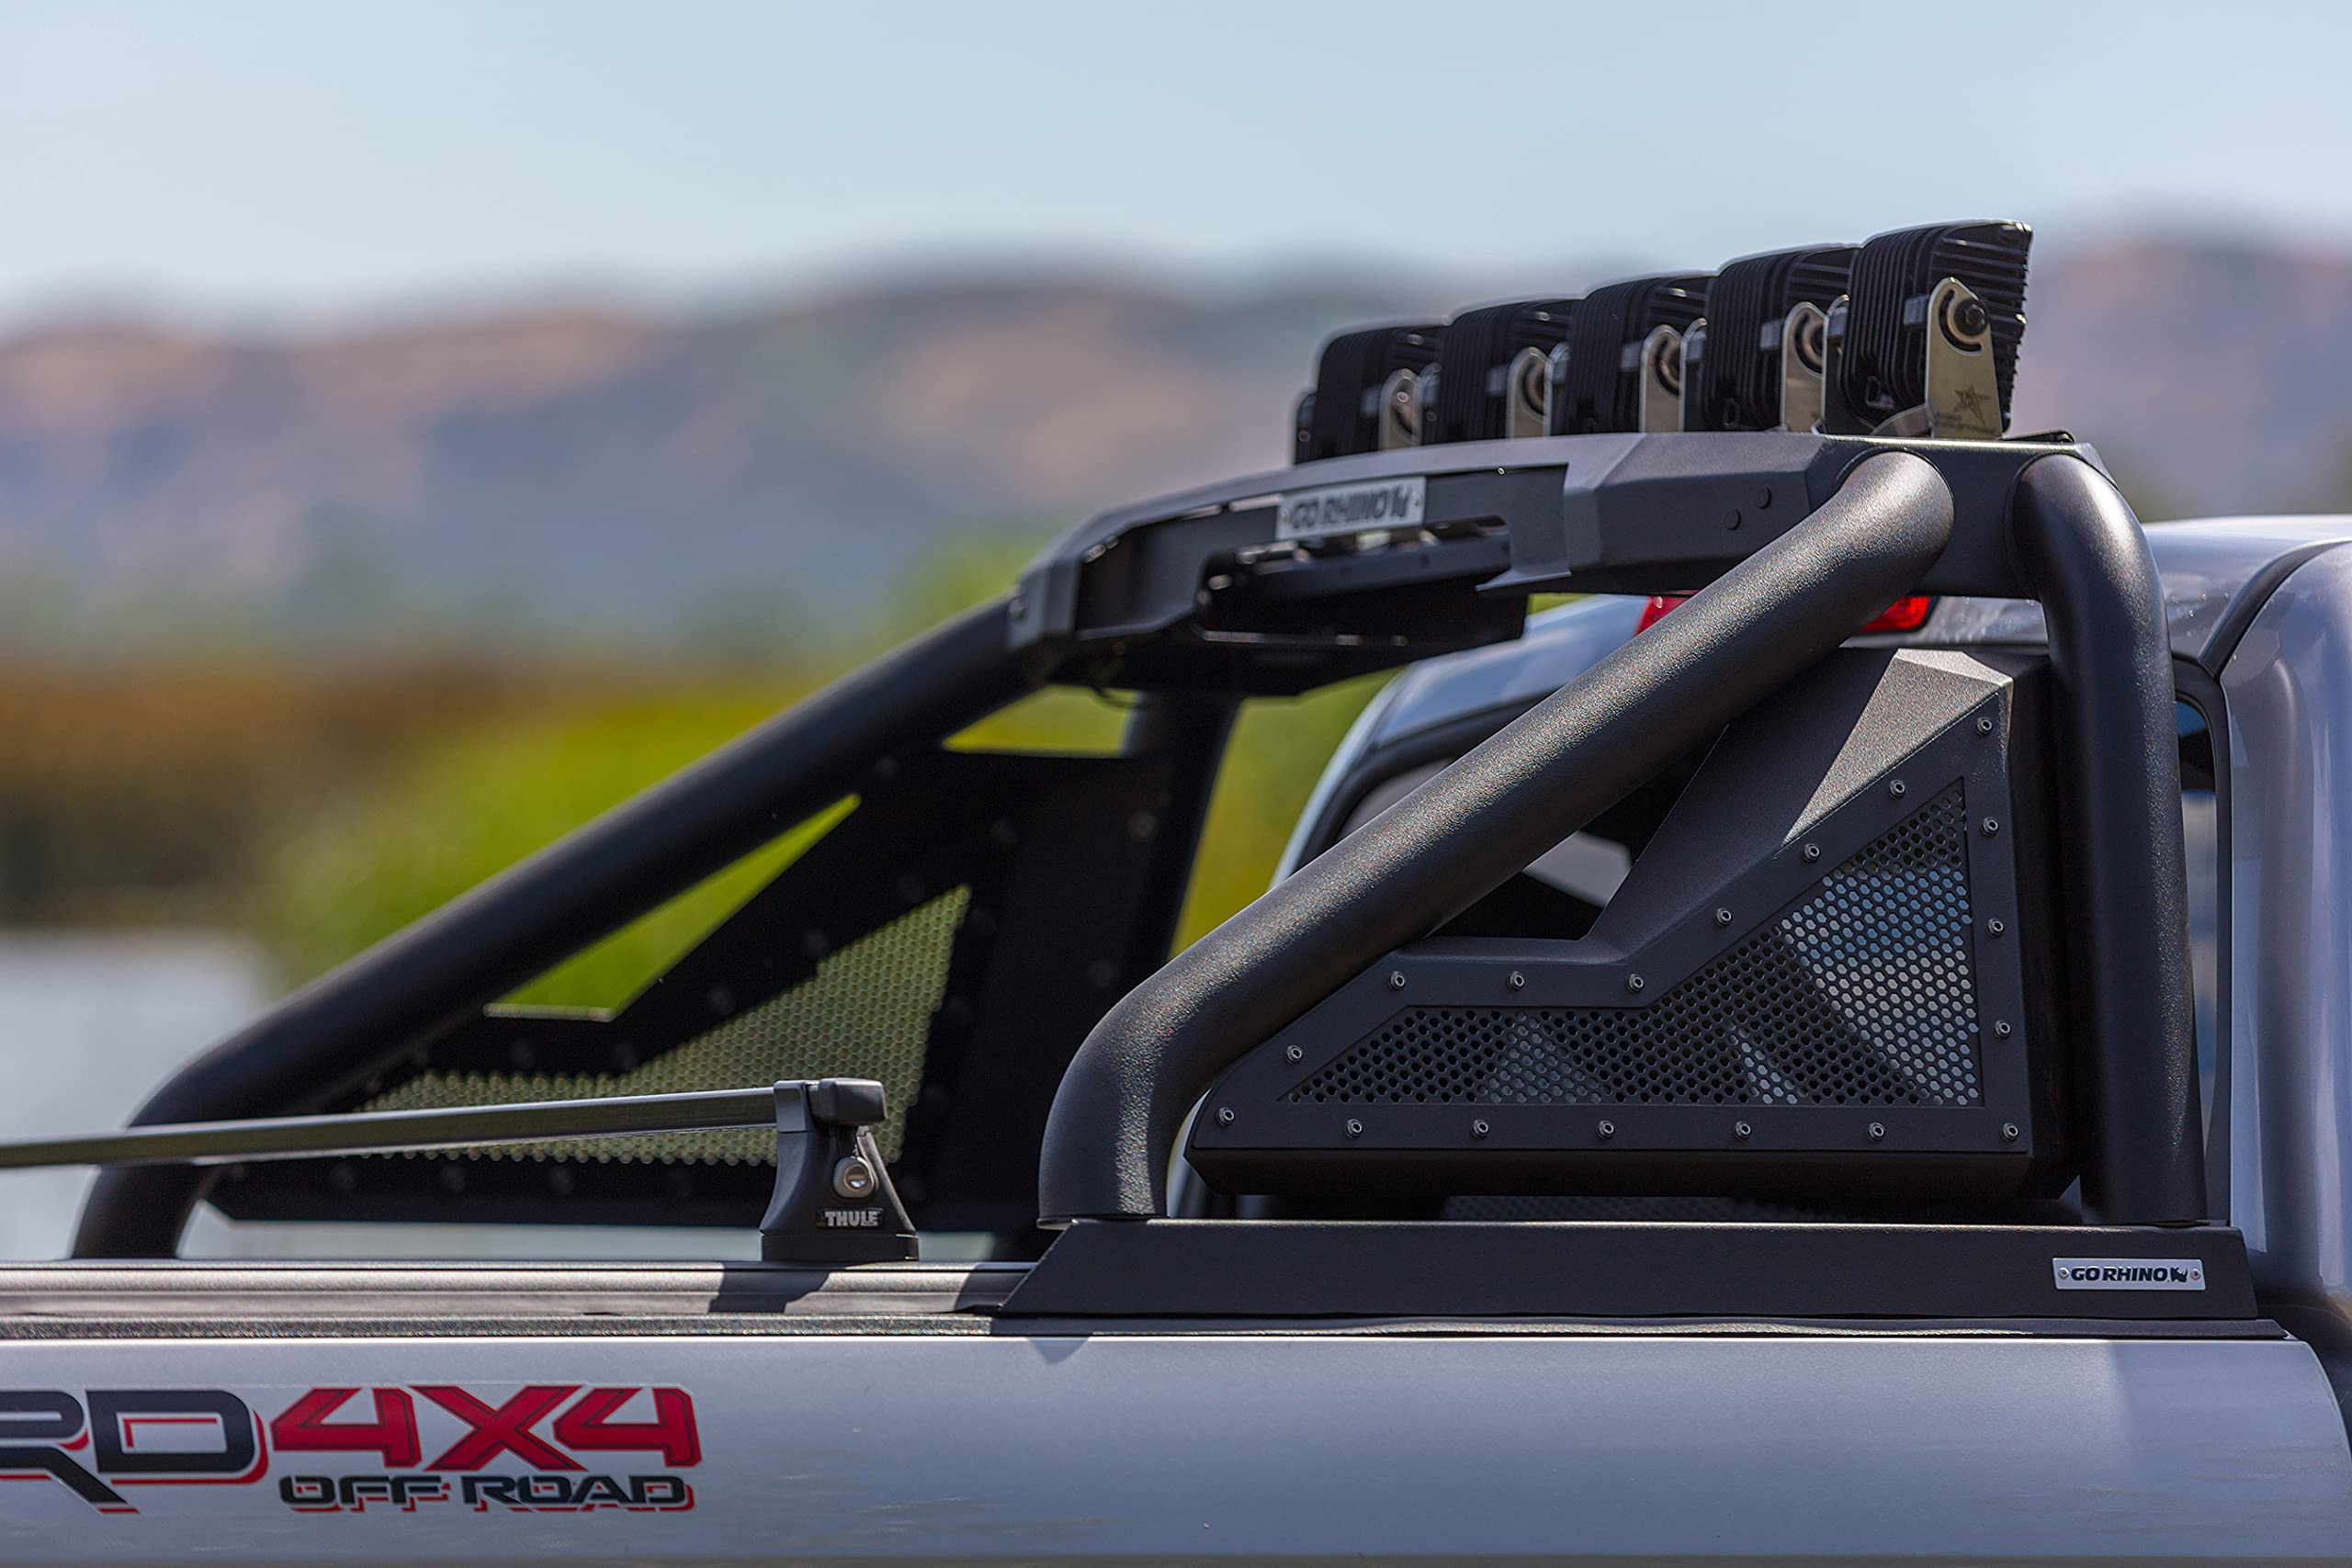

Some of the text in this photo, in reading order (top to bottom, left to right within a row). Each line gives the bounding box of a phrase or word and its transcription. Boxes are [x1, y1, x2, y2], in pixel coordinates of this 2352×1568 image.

[824, 1211, 878, 1226] THULE
[2071, 1266, 2168, 1281] GO RHINO
[268, 1384, 702, 1472] 4X4
[277, 1474, 695, 1513] OFF ROAD
